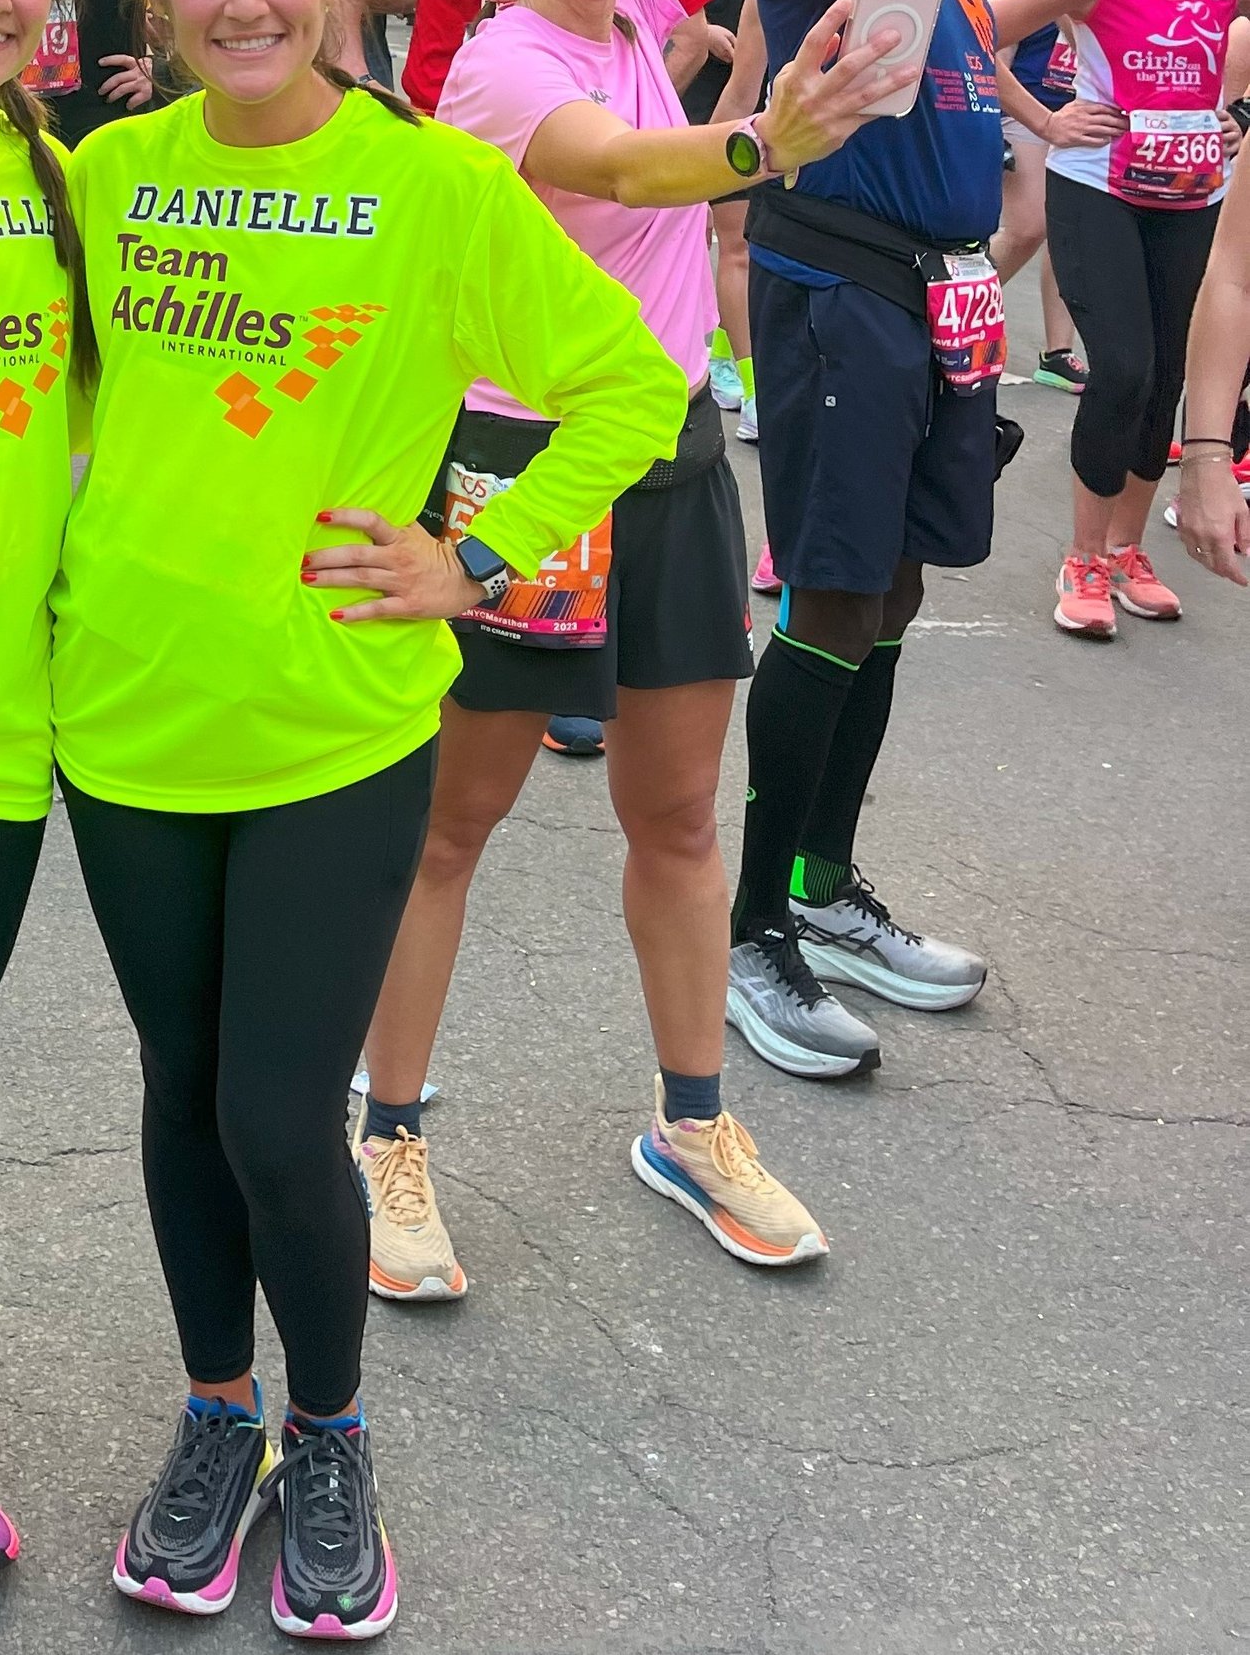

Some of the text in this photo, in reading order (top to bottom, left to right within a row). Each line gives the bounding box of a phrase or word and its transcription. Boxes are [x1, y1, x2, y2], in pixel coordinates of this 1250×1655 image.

[1122, 50, 1188, 70] Girls
[964, 72, 981, 112] 2023
[1137, 70, 1202, 86] the run
[1145, 115, 1168, 129] tcs
[1136, 134, 1221, 163] 47366
[128, 185, 379, 237] DANIELLE
[117, 233, 228, 282] Team
[112, 284, 294, 350] Achilles
[161, 339, 288, 367] INTERNATIONAL
[553, 621, 578, 632] 2023
